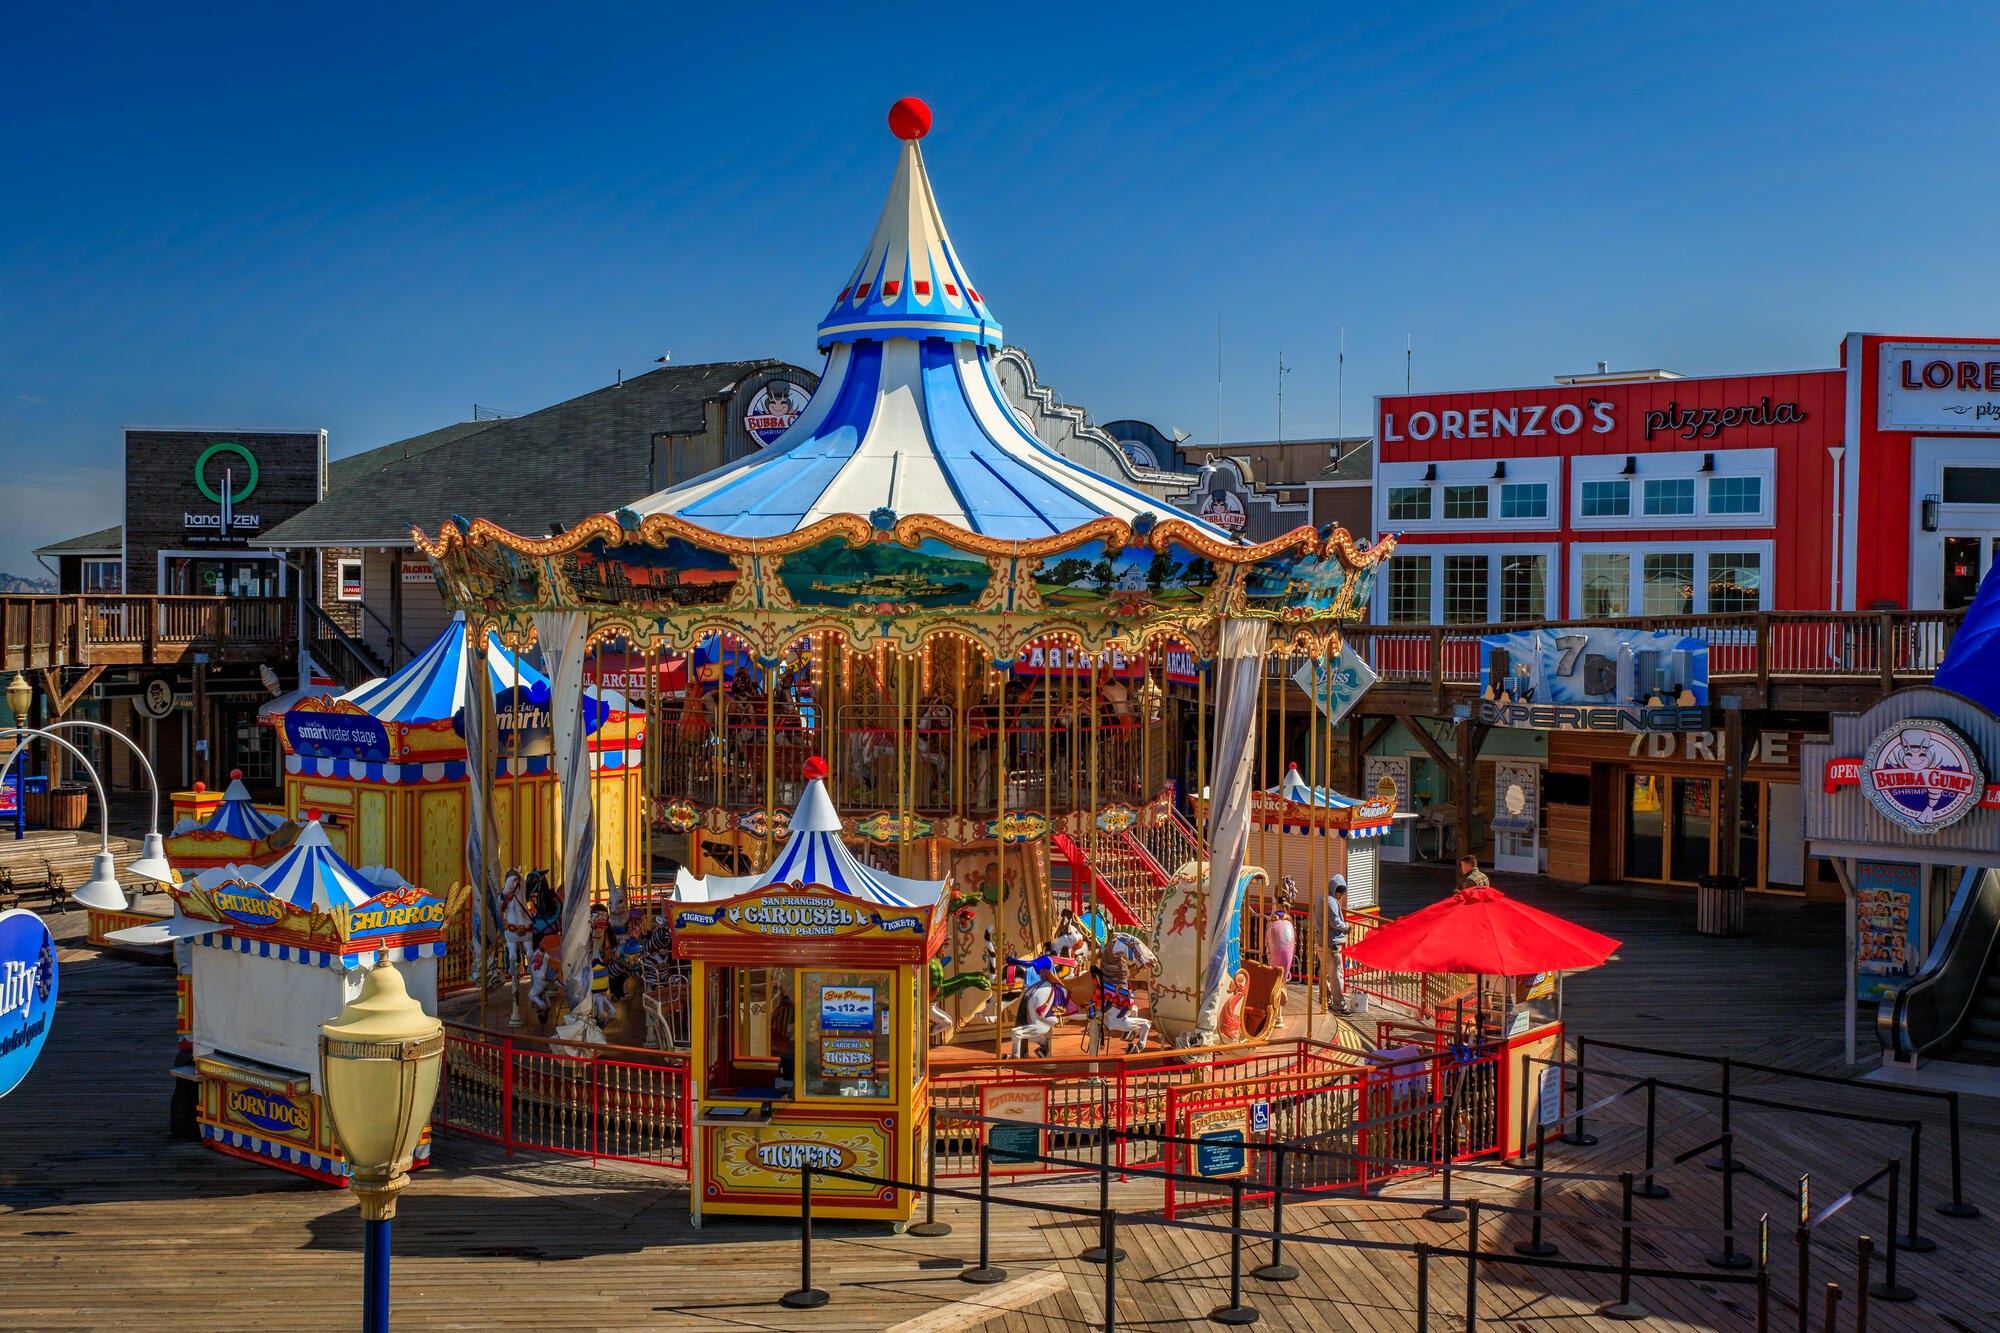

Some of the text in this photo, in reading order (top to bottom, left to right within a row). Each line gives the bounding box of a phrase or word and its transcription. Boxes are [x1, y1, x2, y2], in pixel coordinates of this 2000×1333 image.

[748, 417, 785, 429] BUBBA
[1384, 396, 1807, 442] LORENZO'S pizzeria
[184, 512, 259, 526] hana ZEN
[402, 564, 432, 574] ALCATR
[504, 703, 534, 713] GLCÉAU
[1481, 704, 1703, 730] EXPERIENCE
[298, 725, 377, 746] smartwater stage
[1686, 731, 1789, 764] RIE
[1830, 765, 1861, 779] OPEN
[1876, 771, 1971, 791] BUBBA GUMP
[1892, 788, 1928, 796] SHRIMP
[1860, 864, 1919, 880] HOTOS
[213, 891, 283, 920] CHURROS
[761, 896, 834, 907] SAN FRANCISCO
[350, 902, 446, 933] CHURROS
[681, 912, 715, 924] TICKETS
[744, 907, 853, 926] CAROUSEL
[760, 925, 835, 935] & BAY PLUNGE
[882, 918, 917, 930] TICKETS
[838, 1003, 855, 1012] $12
[823, 1052, 872, 1063] TICKETS
[227, 1090, 310, 1130] CORN DOGS
[759, 1144, 842, 1168] TICKETS
